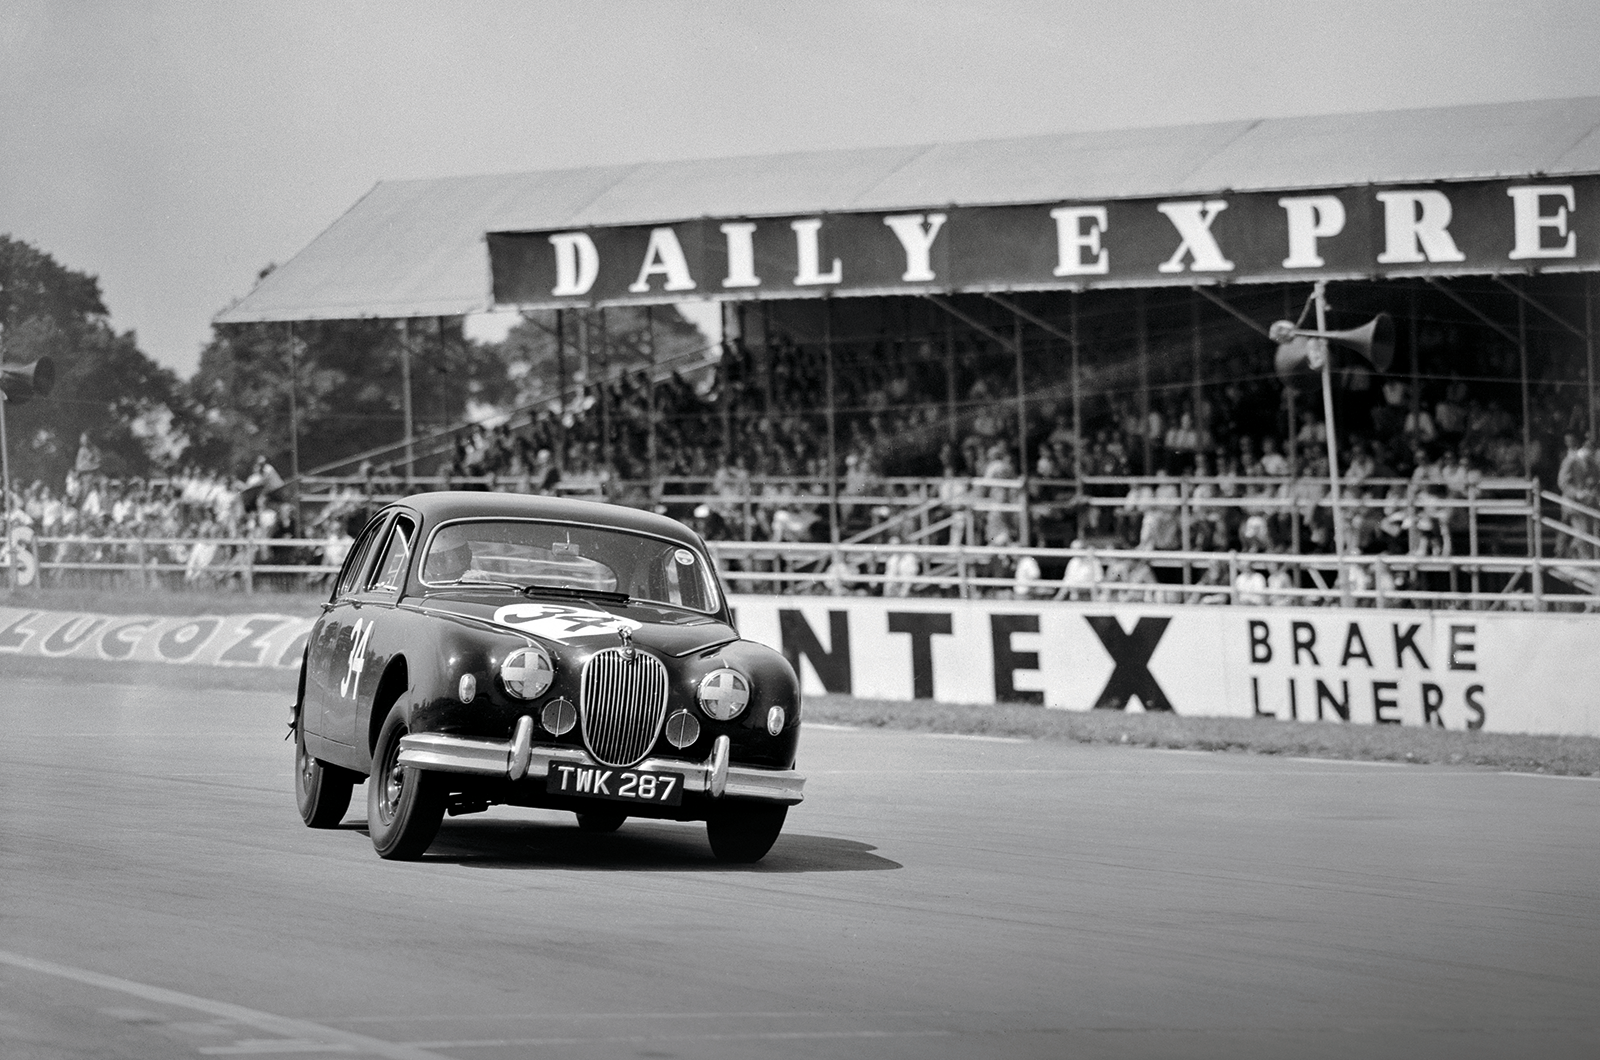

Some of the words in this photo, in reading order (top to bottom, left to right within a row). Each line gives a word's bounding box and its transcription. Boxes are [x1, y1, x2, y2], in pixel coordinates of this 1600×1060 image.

[549, 213, 947, 296] DAILY
[1050, 184, 1577, 276] EXPRE
[503, 605, 622, 632] 34
[1249, 620, 1477, 671] BRAKE
[341, 617, 374, 700] 34
[730, 608, 1176, 712] NTEX
[1253, 677, 1486, 731] LINERS
[558, 766, 613, 795] TWK
[618, 772, 677, 801] 287
